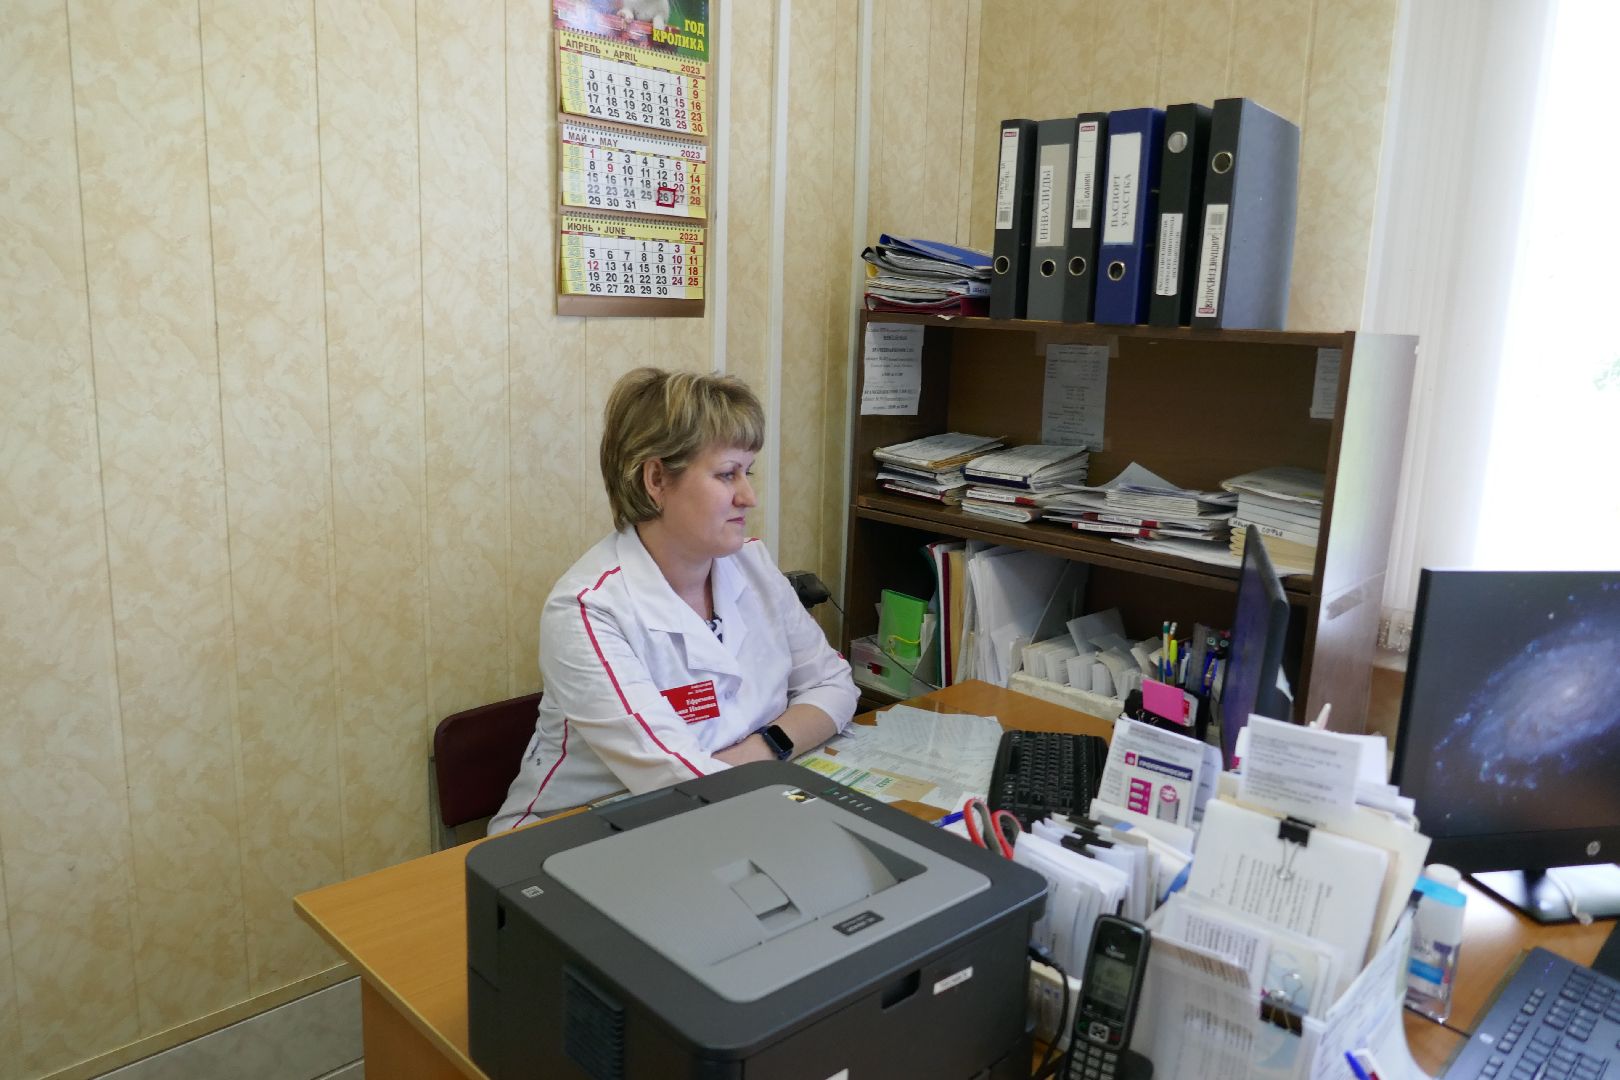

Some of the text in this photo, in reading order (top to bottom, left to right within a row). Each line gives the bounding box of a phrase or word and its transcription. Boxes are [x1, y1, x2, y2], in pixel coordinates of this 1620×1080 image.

[685, 19, 704, 37] ГОД
[653, 29, 704, 51] КРОЛИКА
[566, 39, 700, 74] АПРЕЛЬ APRIL 2023
[589, 70, 698, 99] 3 4 5 6 7 8 9
[677, 76, 698, 88] 1 2
[587, 82, 701, 110] 10 11 12 13 14 15 16
[588, 94, 702, 121] 17 18 19 20 21 22 23
[590, 105, 703, 132] 24 25 26 27 28 29 30
[569, 132, 700, 158] МАЙ MAY 2023
[590, 149, 698, 172] 1 2 3 4 5 6 7
[590, 161, 700, 183] 8 9 10 11 12 13 14
[588, 173, 598, 182] 15
[606, 175, 616, 184] 16
[624, 178, 634, 186] 17
[641, 180, 650, 188] 18
[674, 184, 684, 192] 20
[691, 186, 700, 194] 21
[588, 185, 700, 205] 22 23 24 25 26 27 28
[589, 196, 636, 209] 29 30 31
[1039, 170, 1052, 240] ИНВАЛИДЫ
[1110, 174, 1120, 228] ПАСПОРТ
[1121, 174, 1131, 227] УЧАСТКА
[568, 223, 593, 232] ИЮНЬ
[590, 249, 698, 264] 5 6 7 8 9 10 11
[642, 242, 646, 250] 1
[659, 243, 663, 252] 2
[690, 246, 696, 254] 4
[588, 261, 698, 275] 12 13 14 15 16 17 18
[589, 272, 698, 286] 19 20 21 22 23 24 25
[590, 283, 667, 295] 26 27 28 29 30
